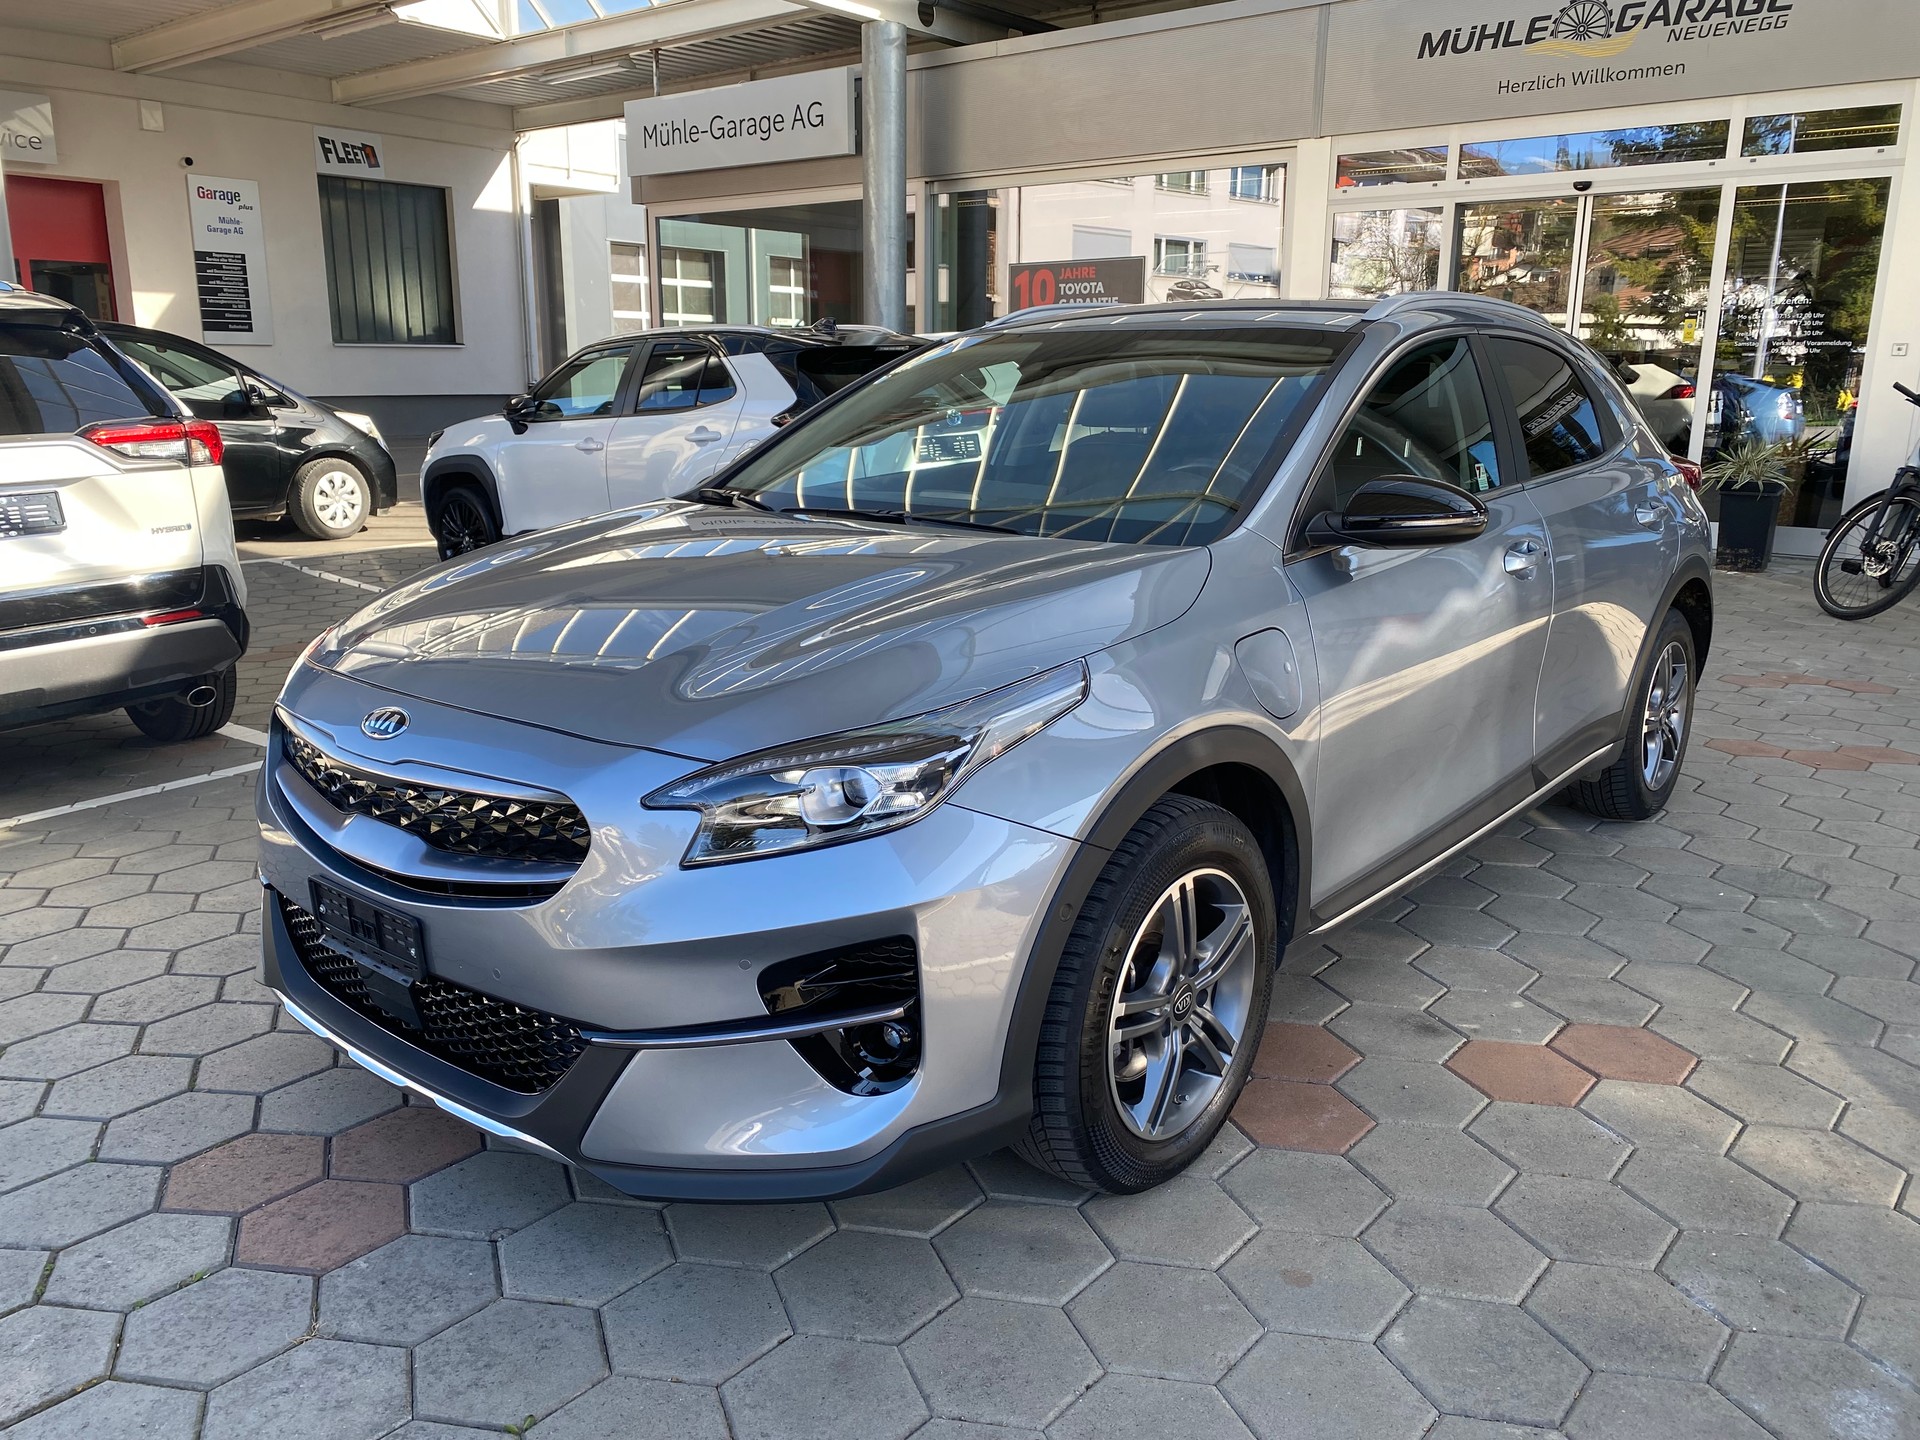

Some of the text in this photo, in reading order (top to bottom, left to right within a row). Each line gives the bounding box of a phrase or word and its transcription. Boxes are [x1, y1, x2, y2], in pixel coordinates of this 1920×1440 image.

[1417, 15, 1552, 59] MÜHLE
[1667, 14, 1789, 43] NEUENEGG
[1498, 63, 1686, 94] Herzlich Willkommen
[643, 101, 824, 148] Mühle-Garage AG
[197, 186, 241, 205] Garage
[206, 225, 244, 235] Garage AG
[218, 216, 243, 225] Mühle-
[1059, 266, 1096, 279] JAHRE
[1014, 269, 1056, 310] 10
[1058, 281, 1105, 295] TOYOTA
[151, 524, 186, 534] HYBRID
[365, 711, 401, 733] KIA
